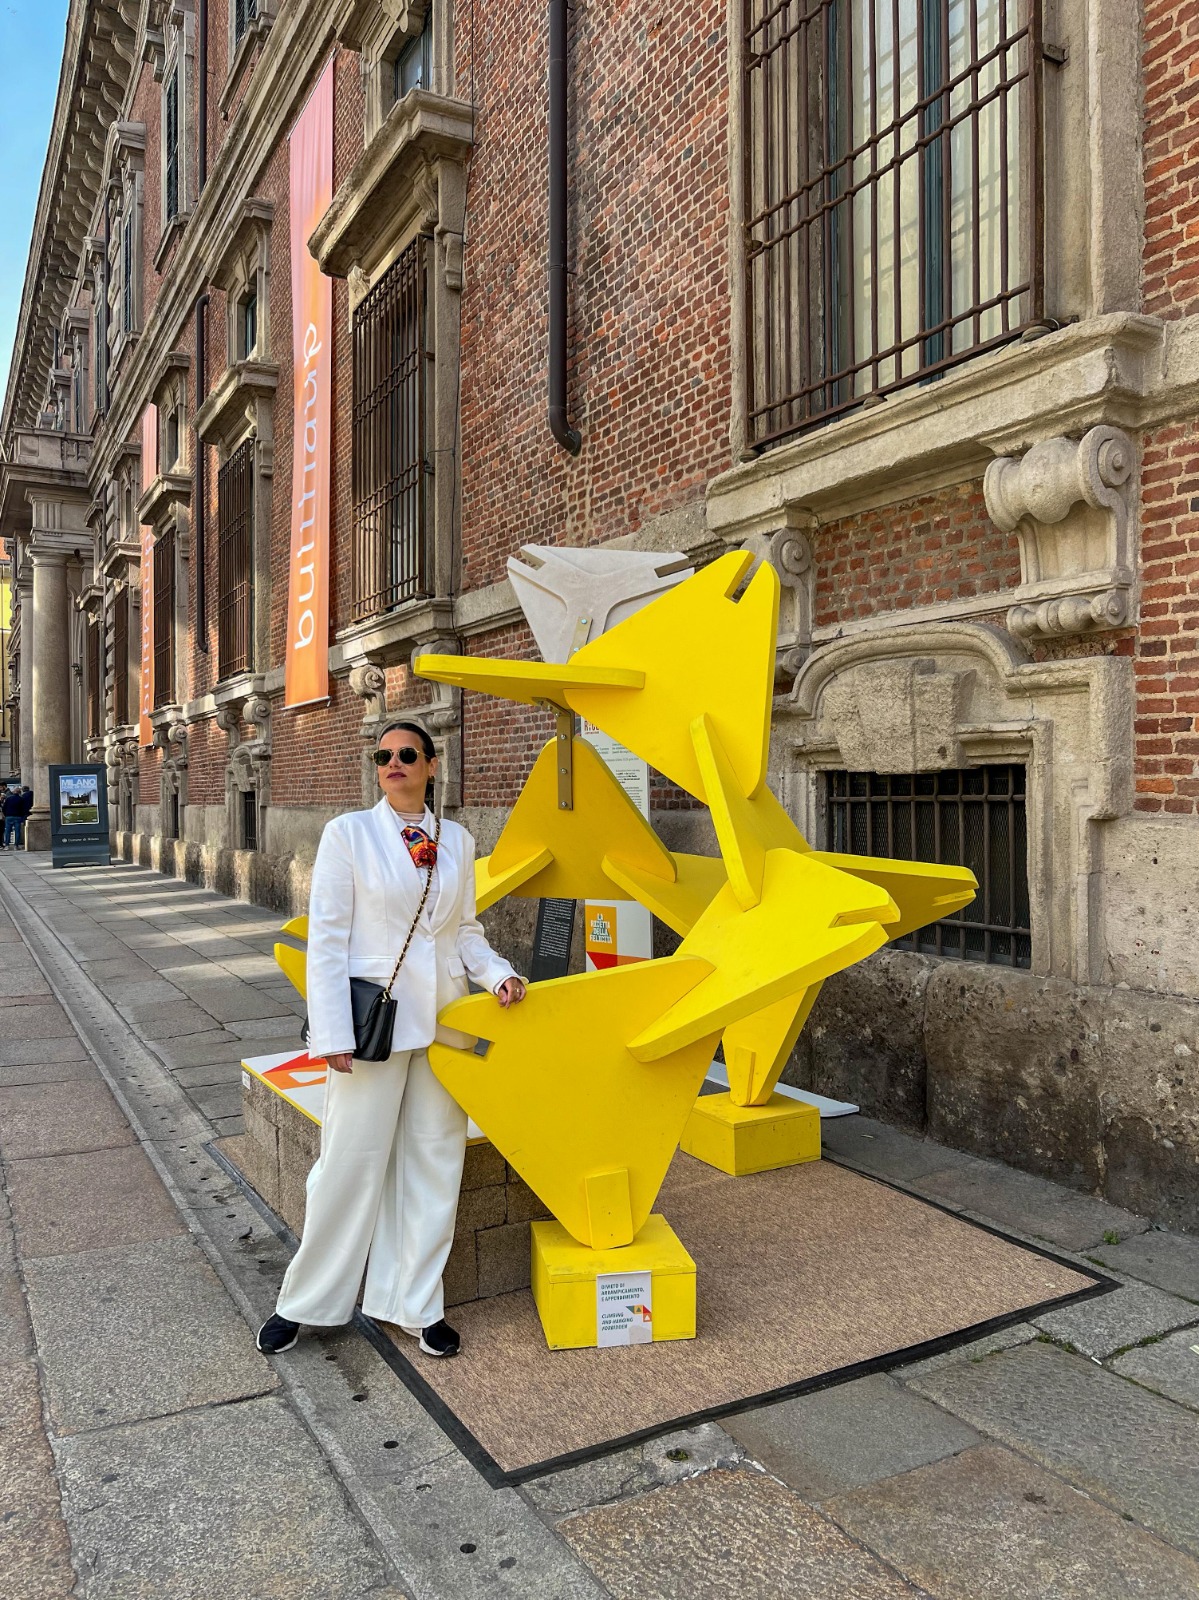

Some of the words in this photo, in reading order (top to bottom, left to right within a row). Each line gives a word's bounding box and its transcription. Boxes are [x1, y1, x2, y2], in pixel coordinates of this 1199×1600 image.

[294, 322, 321, 649] bulthaup
[61, 778, 96, 787] MILANO
[590, 919, 611, 929] RICETTA
[593, 927, 609, 936] DELLA
